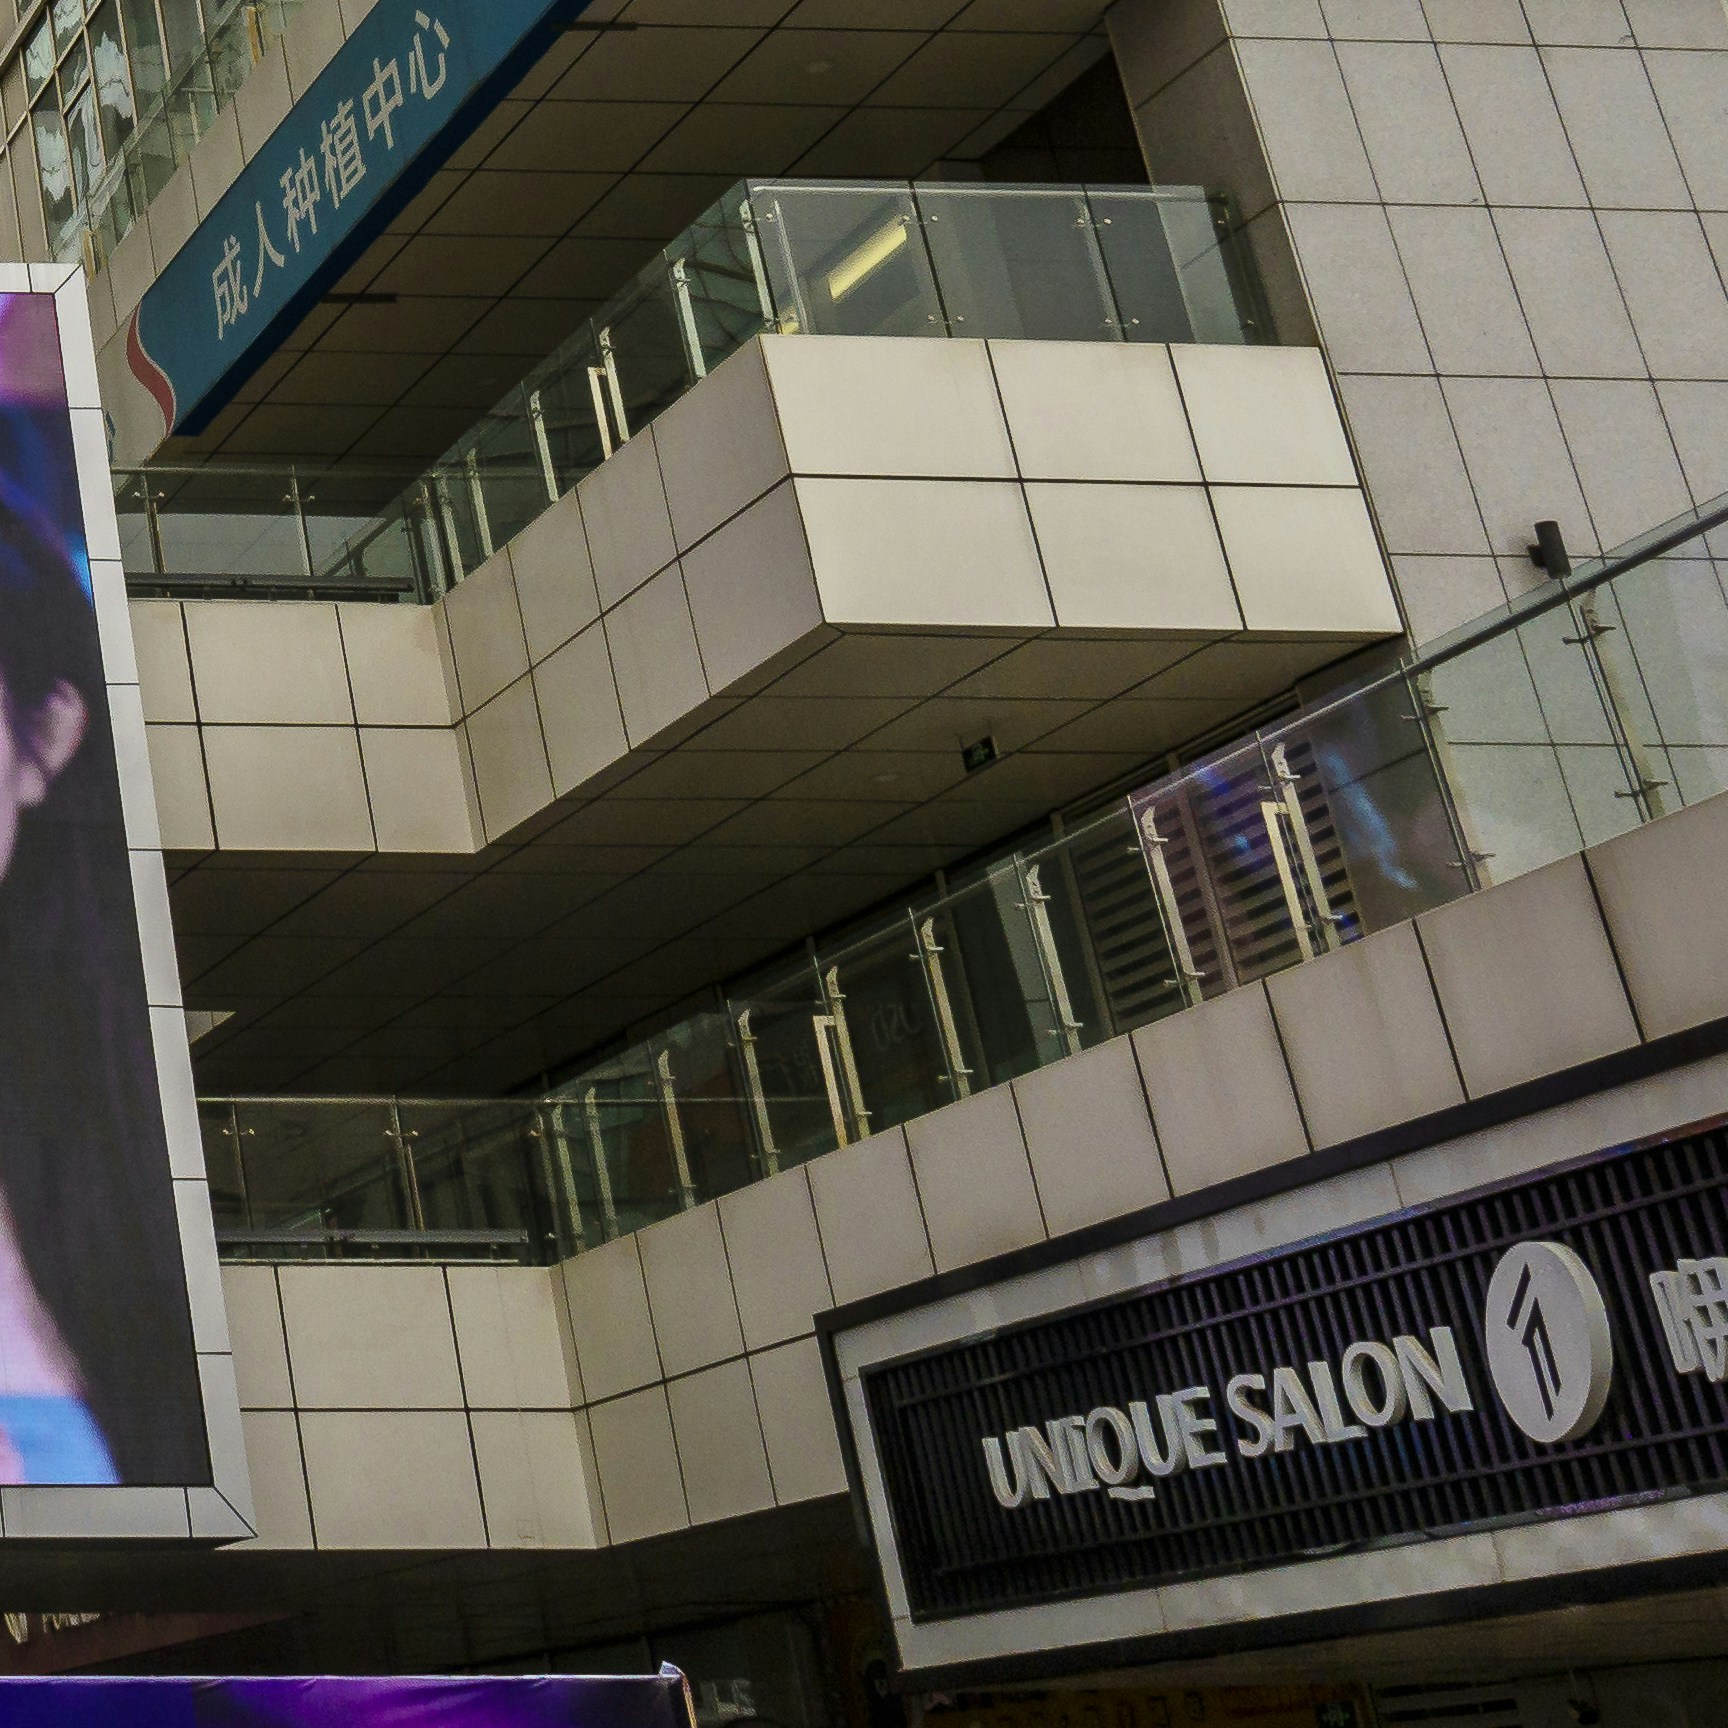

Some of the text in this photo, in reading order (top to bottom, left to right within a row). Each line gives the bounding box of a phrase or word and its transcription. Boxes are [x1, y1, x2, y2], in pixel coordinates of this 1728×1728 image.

[211, 9, 452, 341] 成人种植中心
[981, 1325, 1474, 1509] UNIQUE SALON
